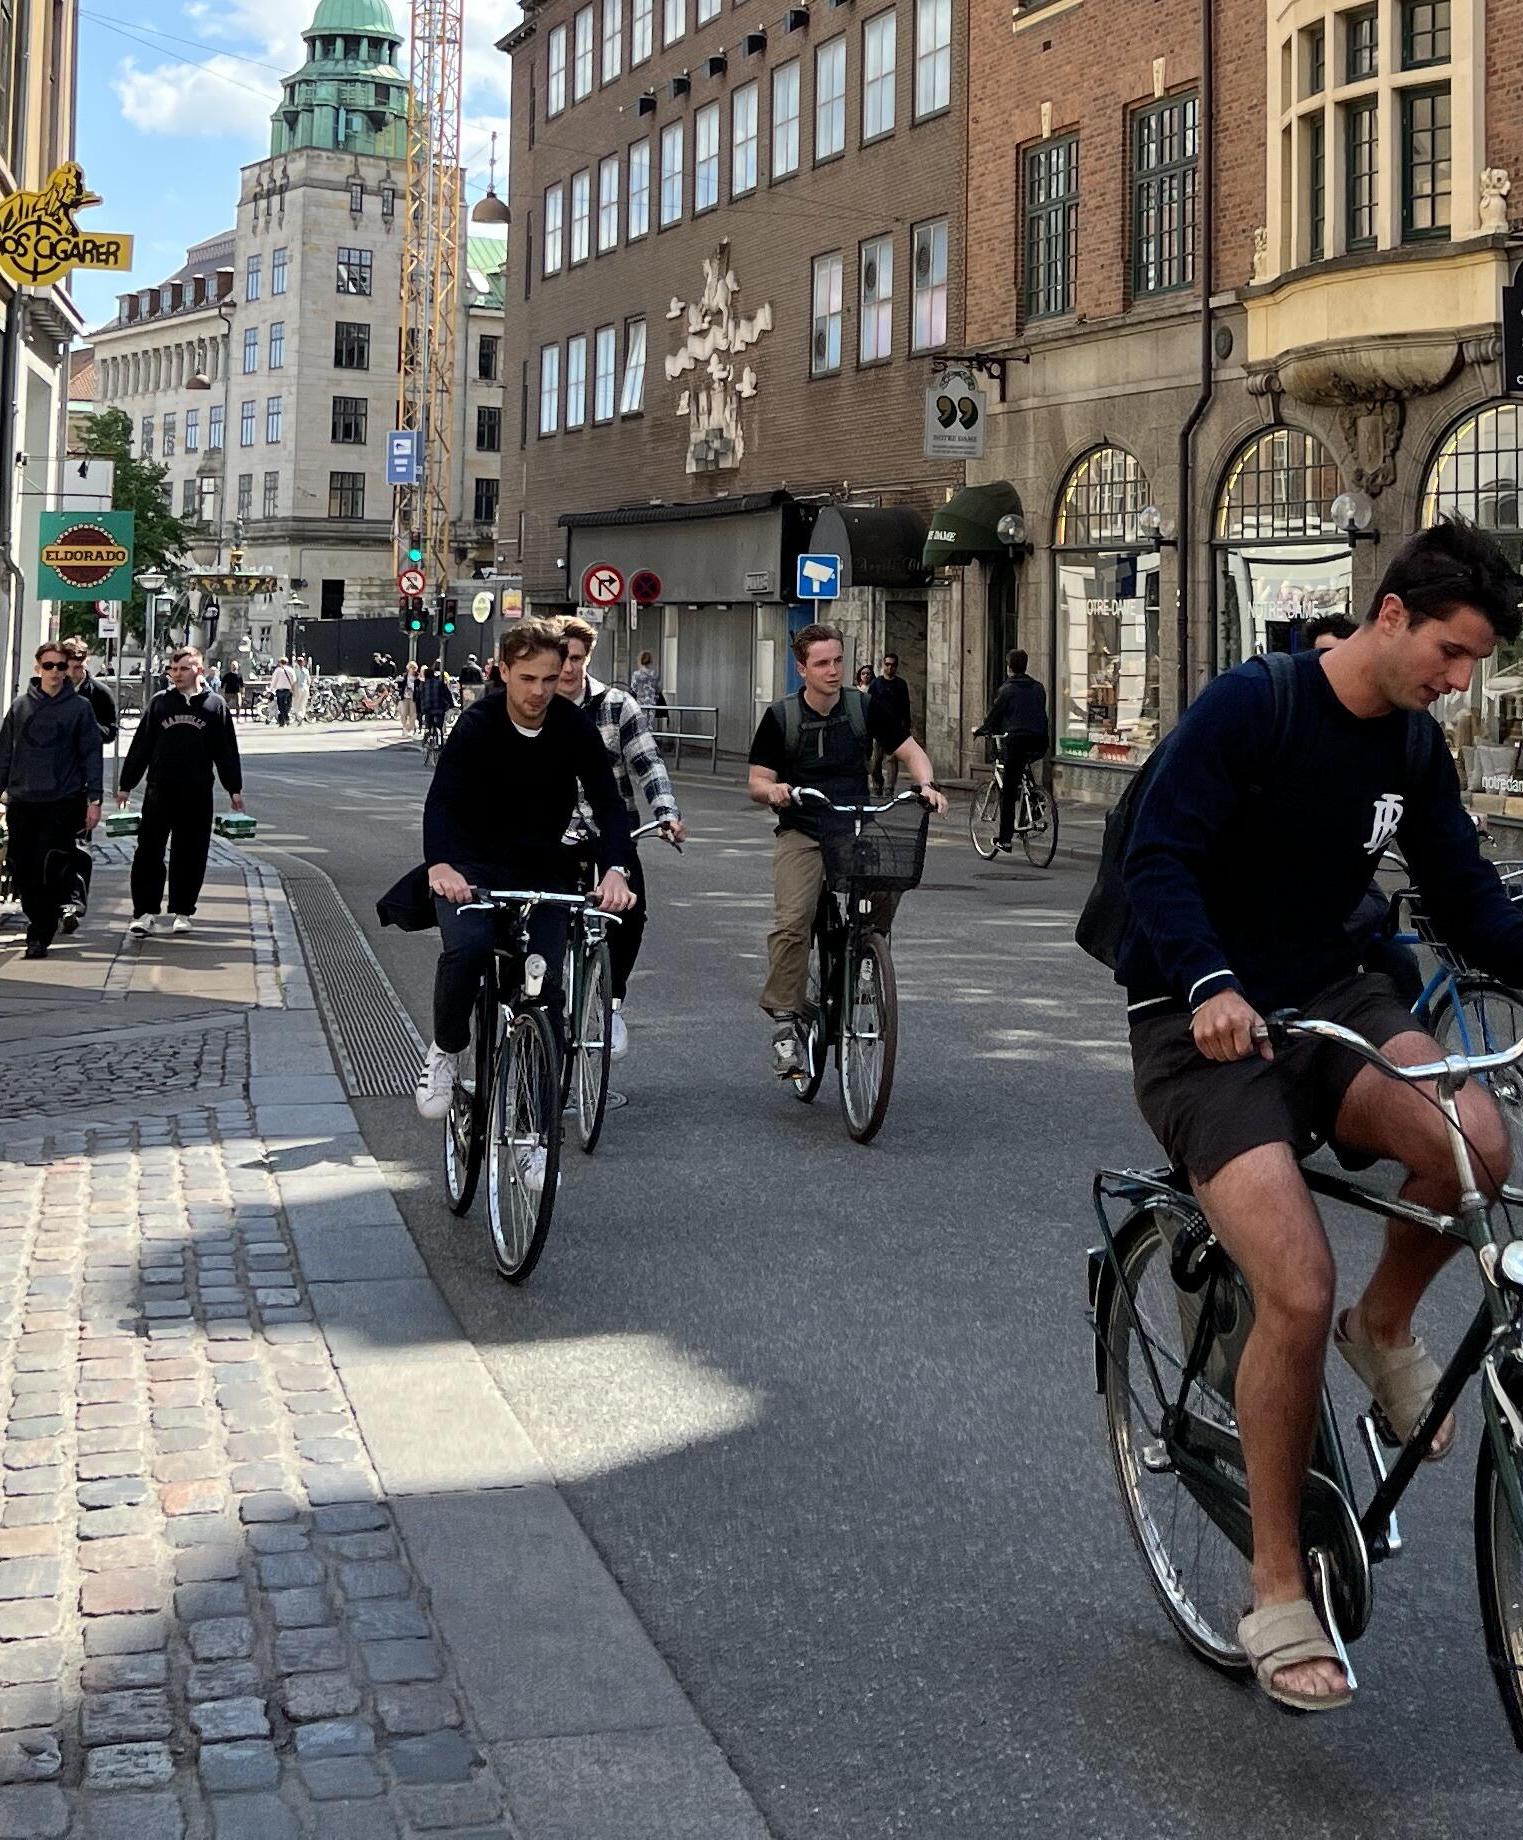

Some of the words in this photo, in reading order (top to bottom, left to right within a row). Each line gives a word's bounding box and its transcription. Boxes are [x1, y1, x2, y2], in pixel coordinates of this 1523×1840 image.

[0, 232, 31, 258] OS
[34, 235, 120, 266] CIGARER
[45, 550, 126, 562] ELDORADO
